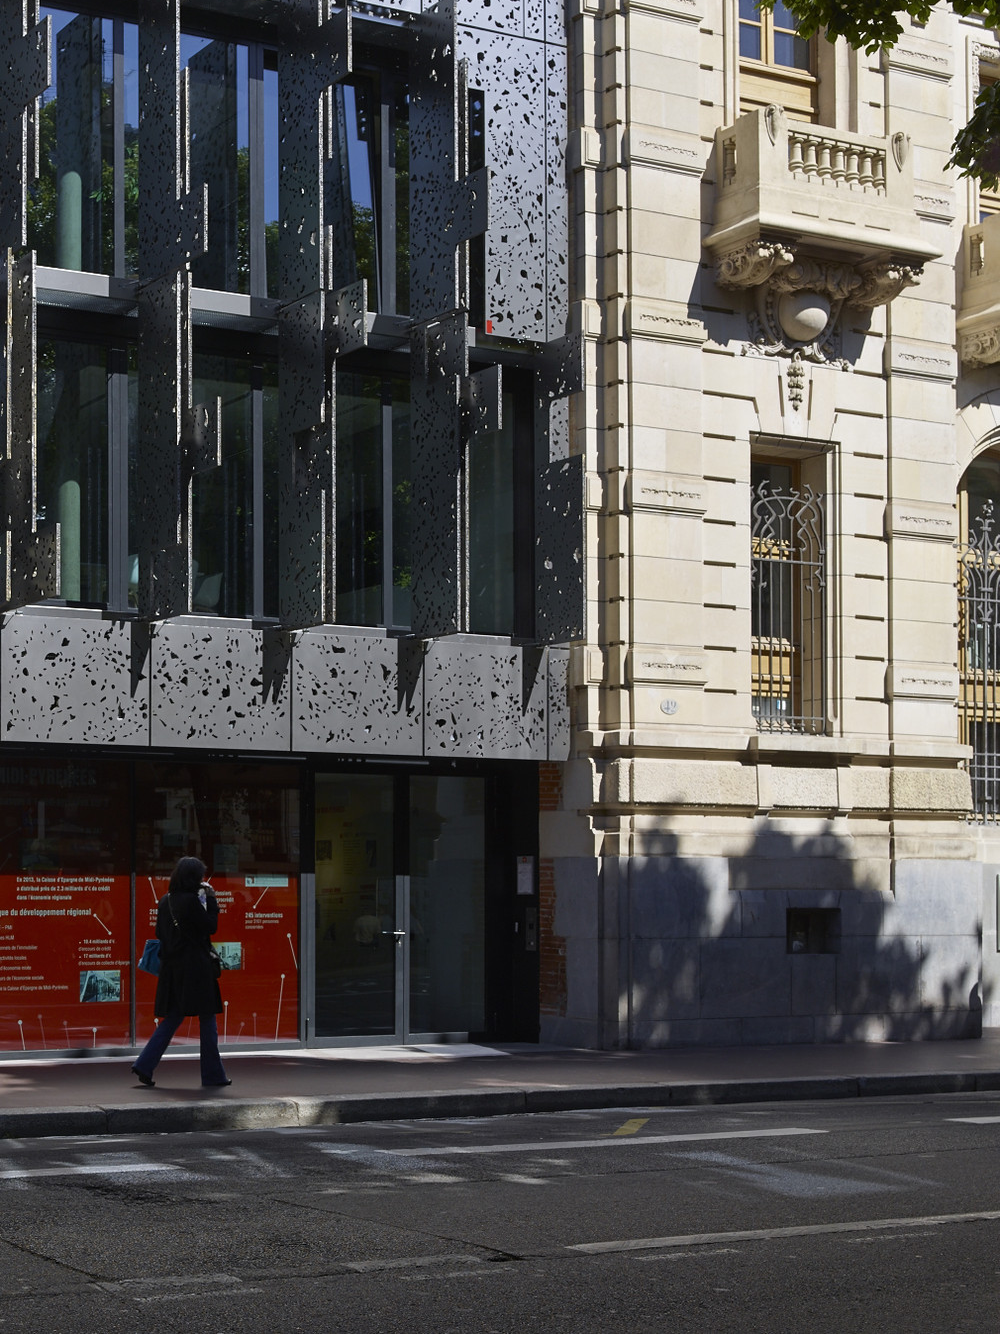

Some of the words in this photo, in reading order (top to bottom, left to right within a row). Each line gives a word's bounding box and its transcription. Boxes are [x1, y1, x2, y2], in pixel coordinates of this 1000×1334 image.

[10, 908, 19, 916] du
[19, 908, 66, 918] développement
[66, 908, 92, 917] régional
